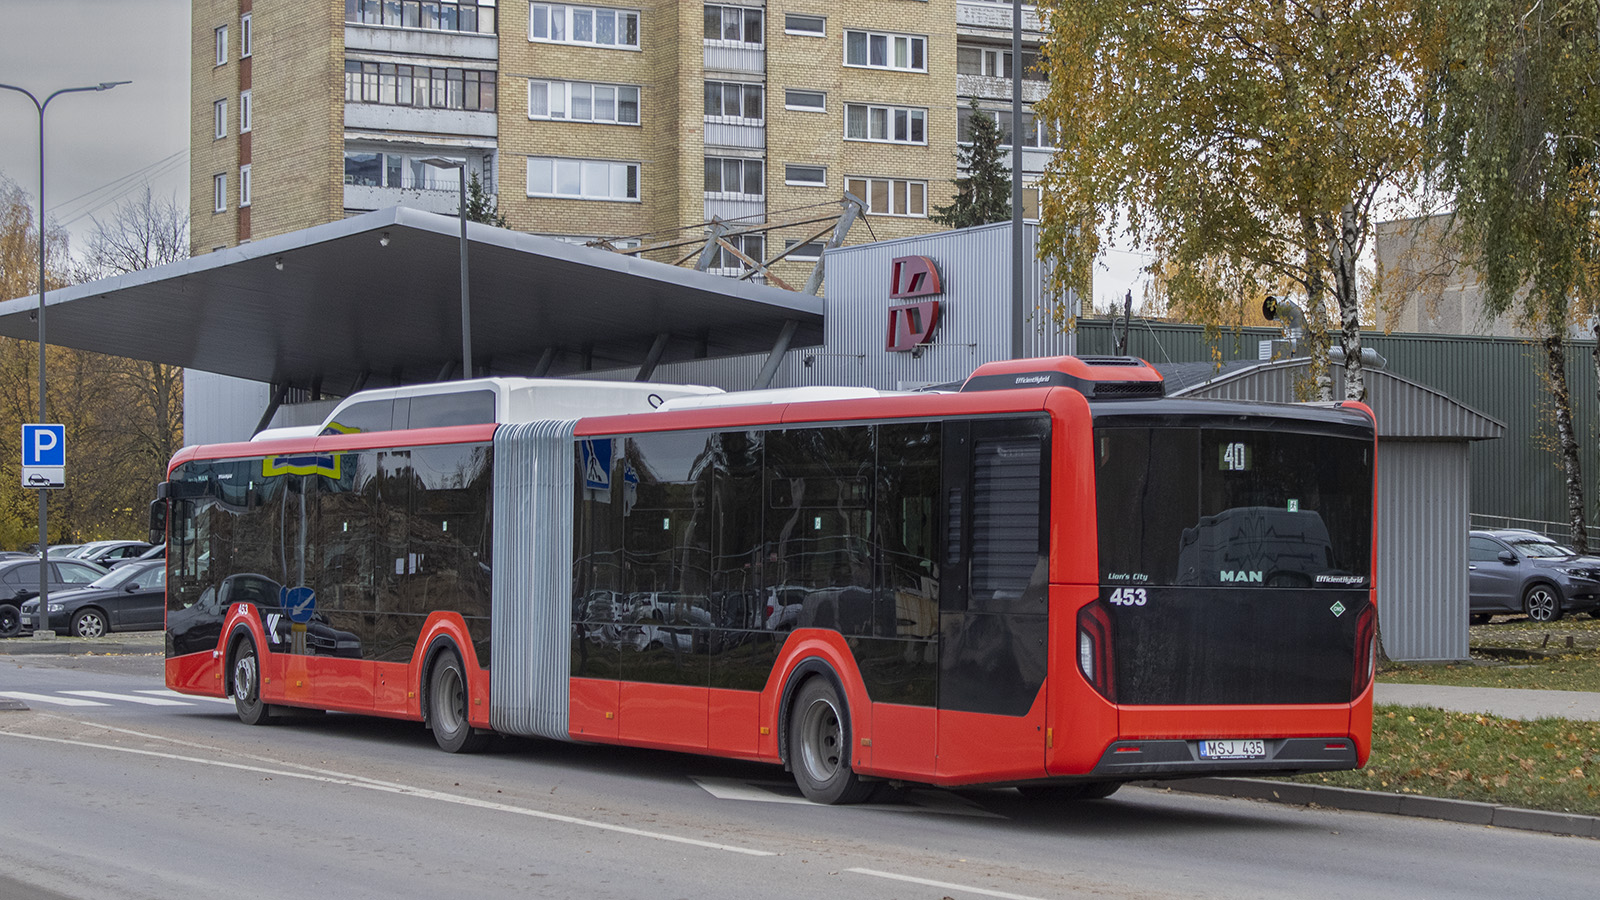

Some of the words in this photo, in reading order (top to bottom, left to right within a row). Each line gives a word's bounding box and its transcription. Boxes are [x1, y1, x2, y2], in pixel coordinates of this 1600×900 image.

[34, 429, 58, 462] P
[1223, 442, 1245, 471] 40
[1107, 572, 1130, 580] Lion's
[1132, 573, 1149, 582] City
[1220, 570, 1263, 583] MAN
[1109, 587, 1147, 606] 453
[238, 603, 249, 615] 453
[1208, 742, 1235, 754] MSJ
[1242, 742, 1263, 754] 435
